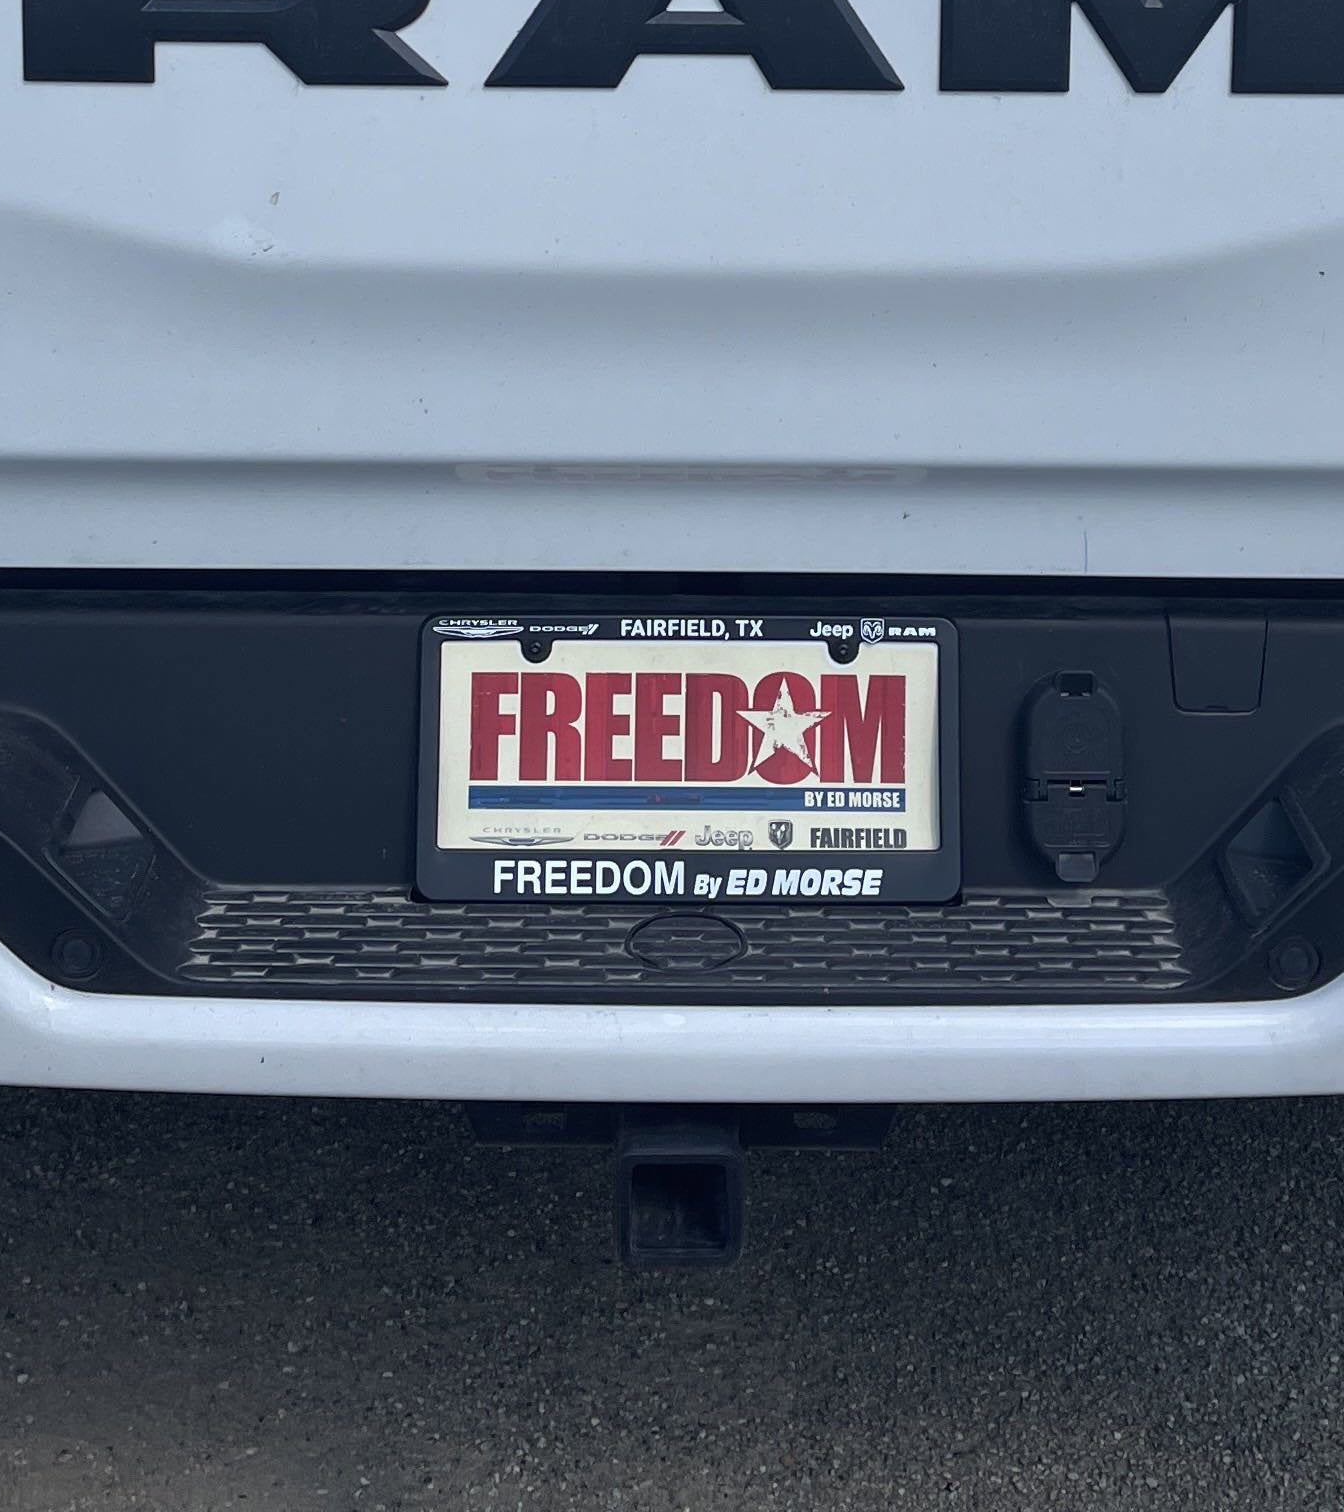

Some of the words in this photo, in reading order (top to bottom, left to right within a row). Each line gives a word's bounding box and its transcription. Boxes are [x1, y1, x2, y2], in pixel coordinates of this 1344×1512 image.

[620, 619, 729, 640] FAIRFIELD,
[735, 620, 763, 637] TX
[810, 621, 854, 640] Jeep
[888, 627, 937, 637] RAM
[470, 671, 906, 785] FREEDOM
[804, 791, 824, 808] BY
[827, 792, 845, 808] ED
[848, 792, 900, 808] MORSE
[694, 825, 755, 850] Jeep
[810, 827, 907, 849] FAIRFIELD
[494, 860, 685, 895] FREEDOM
[694, 874, 723, 899] By
[726, 869, 768, 896] ED
[771, 868, 884, 896] MORSE
